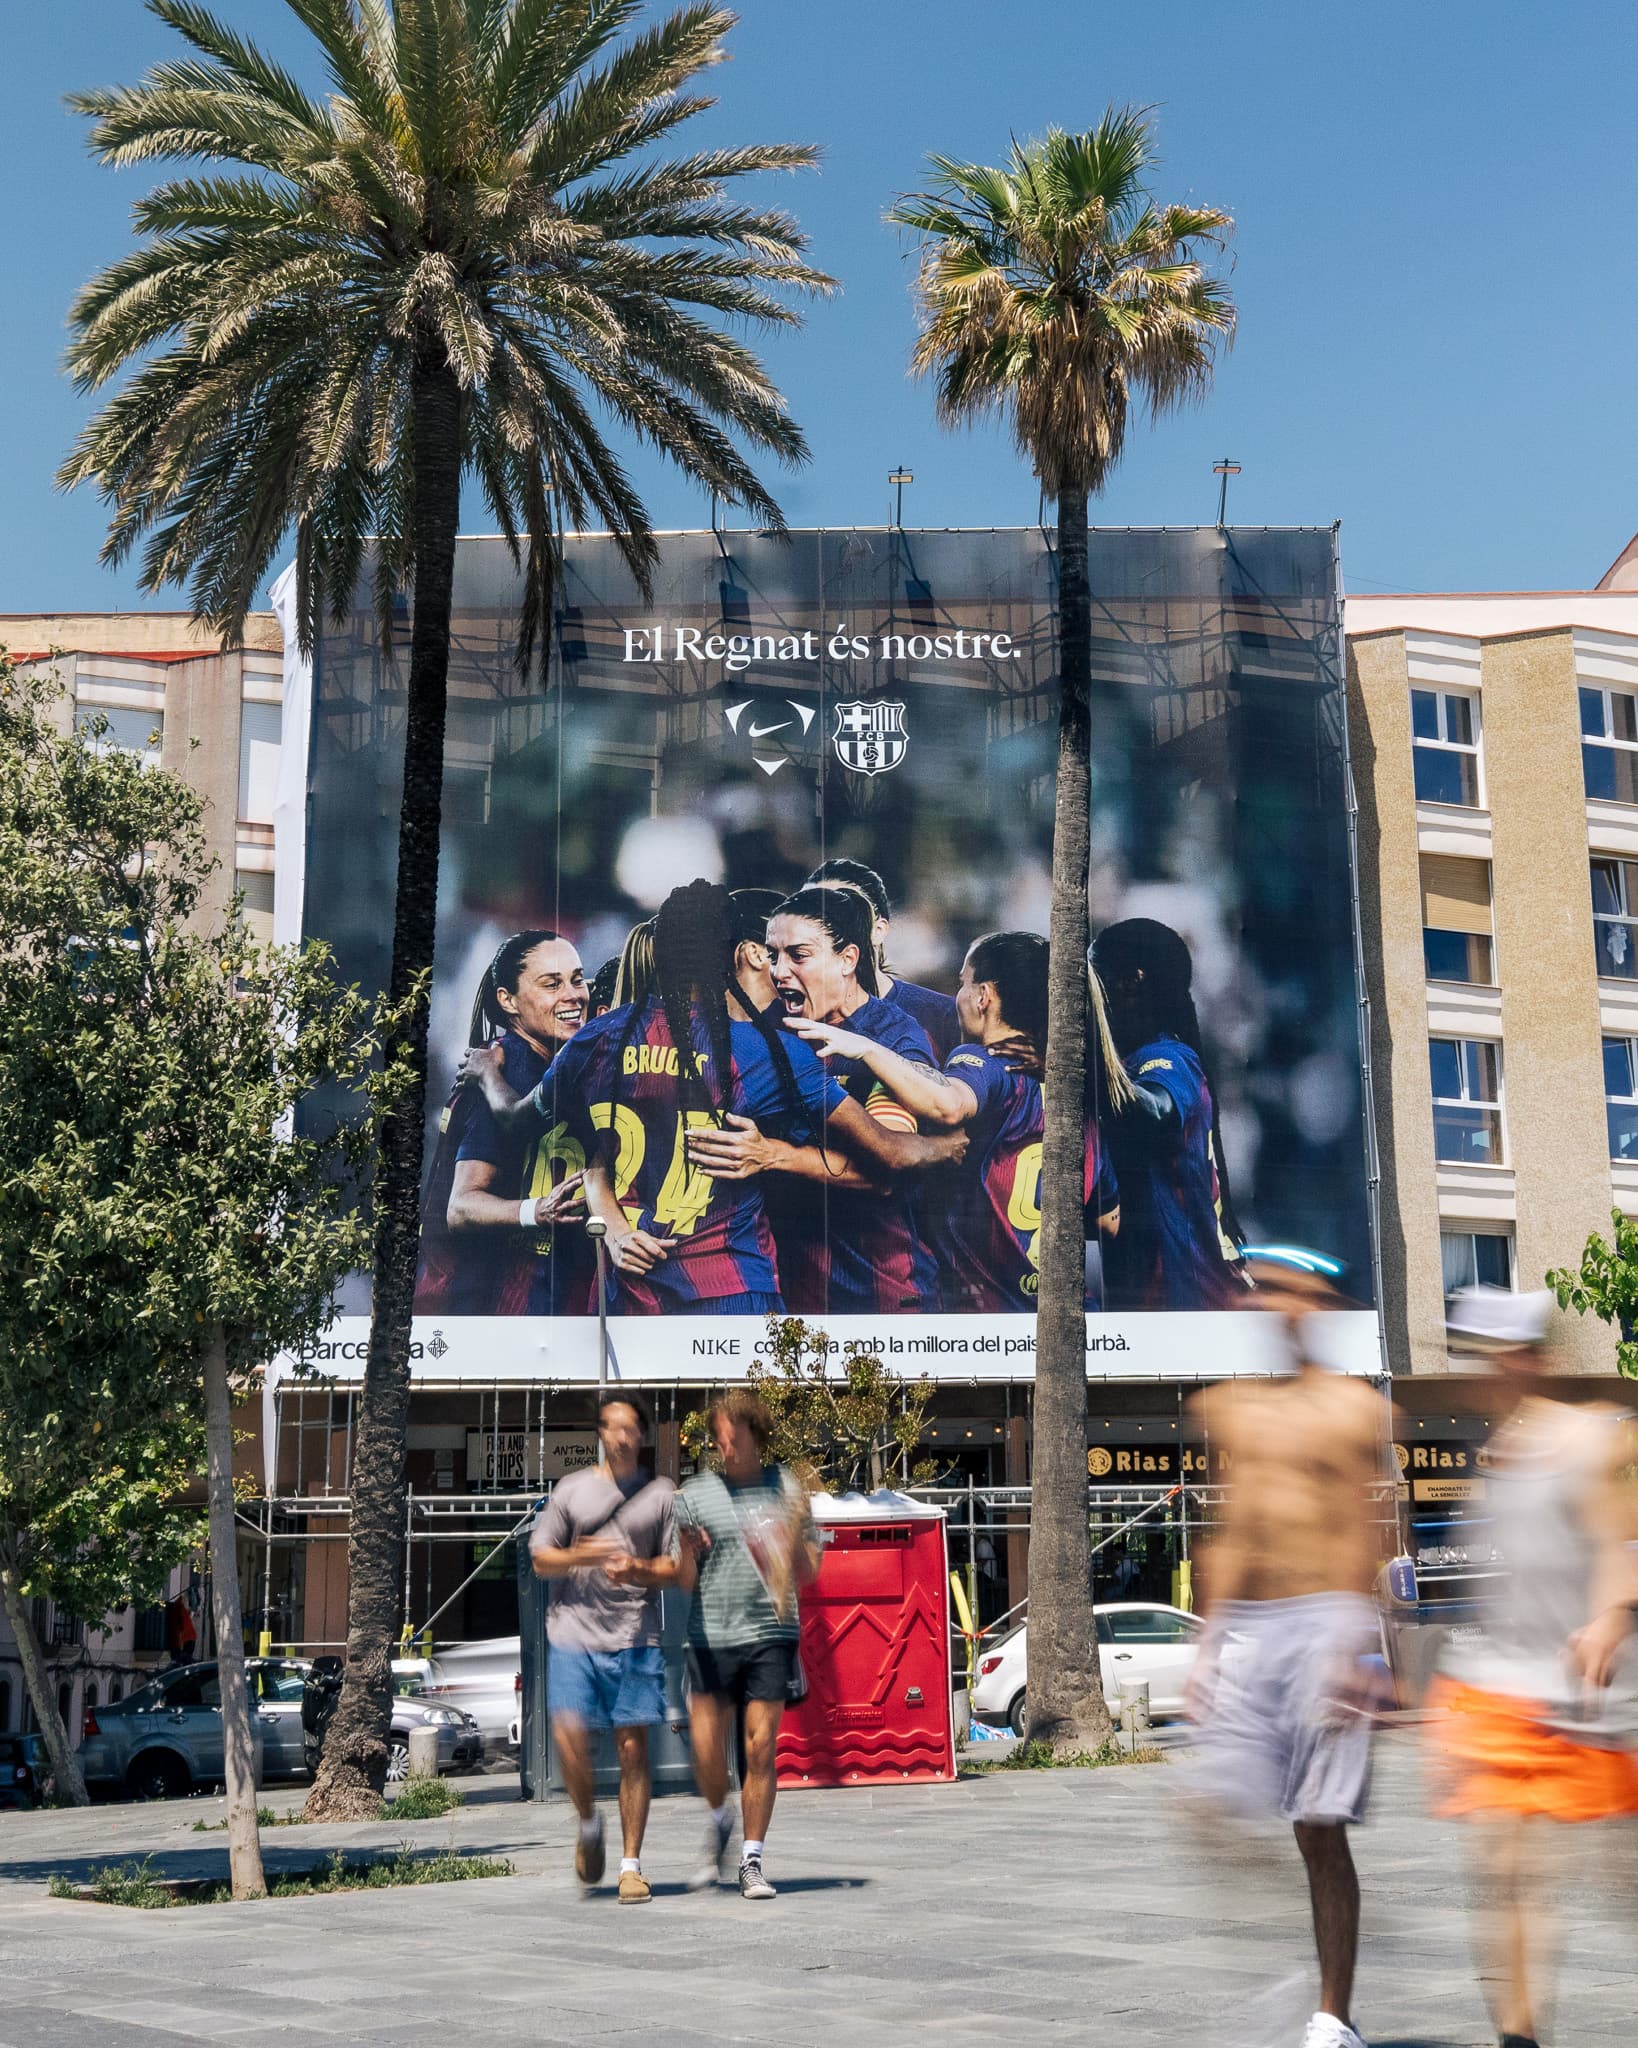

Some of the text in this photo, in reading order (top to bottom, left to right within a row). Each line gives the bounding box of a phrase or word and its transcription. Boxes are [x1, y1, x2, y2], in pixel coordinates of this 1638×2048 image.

[623, 624, 1021, 671] El Regnat és nostre.
[857, 732, 884, 741] FCB
[300, 1337, 424, 1360] Barcea
[692, 1338, 741, 1355] NIKE
[844, 1336, 885, 1354] amb
[889, 1336, 905, 1353] la
[907, 1336, 969, 1353] millora
[972, 1336, 1000, 1352] del
[1085, 1334, 1131, 1351] urbà.
[487, 1435, 524, 1452] FIH AND
[1116, 1451, 1170, 1471] Rias
[1182, 1450, 1208, 1471] do
[1413, 1448, 1467, 1468] Rias
